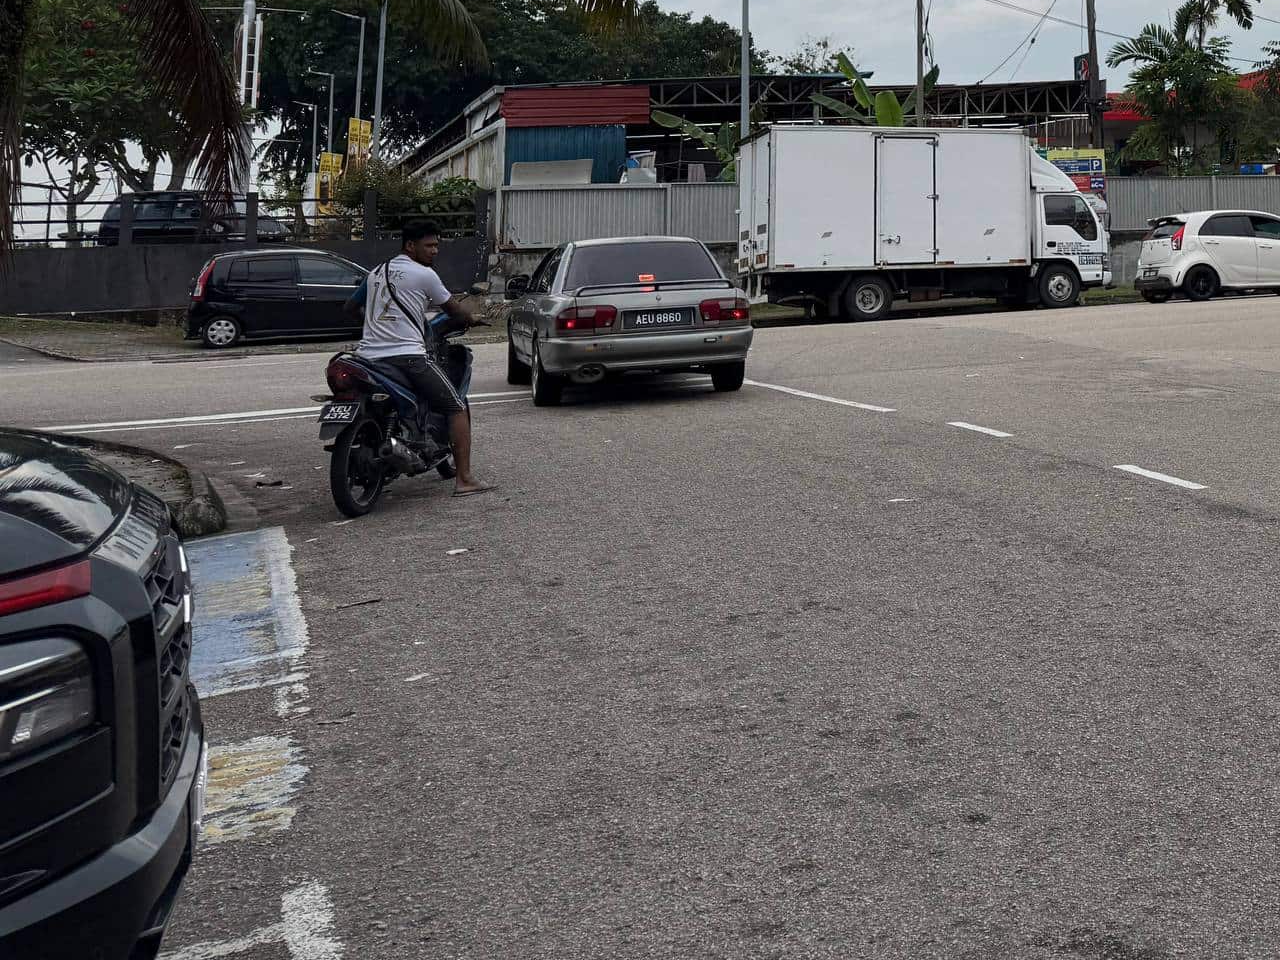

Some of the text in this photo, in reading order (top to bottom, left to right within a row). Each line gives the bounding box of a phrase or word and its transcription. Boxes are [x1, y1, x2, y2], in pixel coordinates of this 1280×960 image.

[1093, 160, 1100, 170] P
[635, 312, 681, 325] AEU 8860
